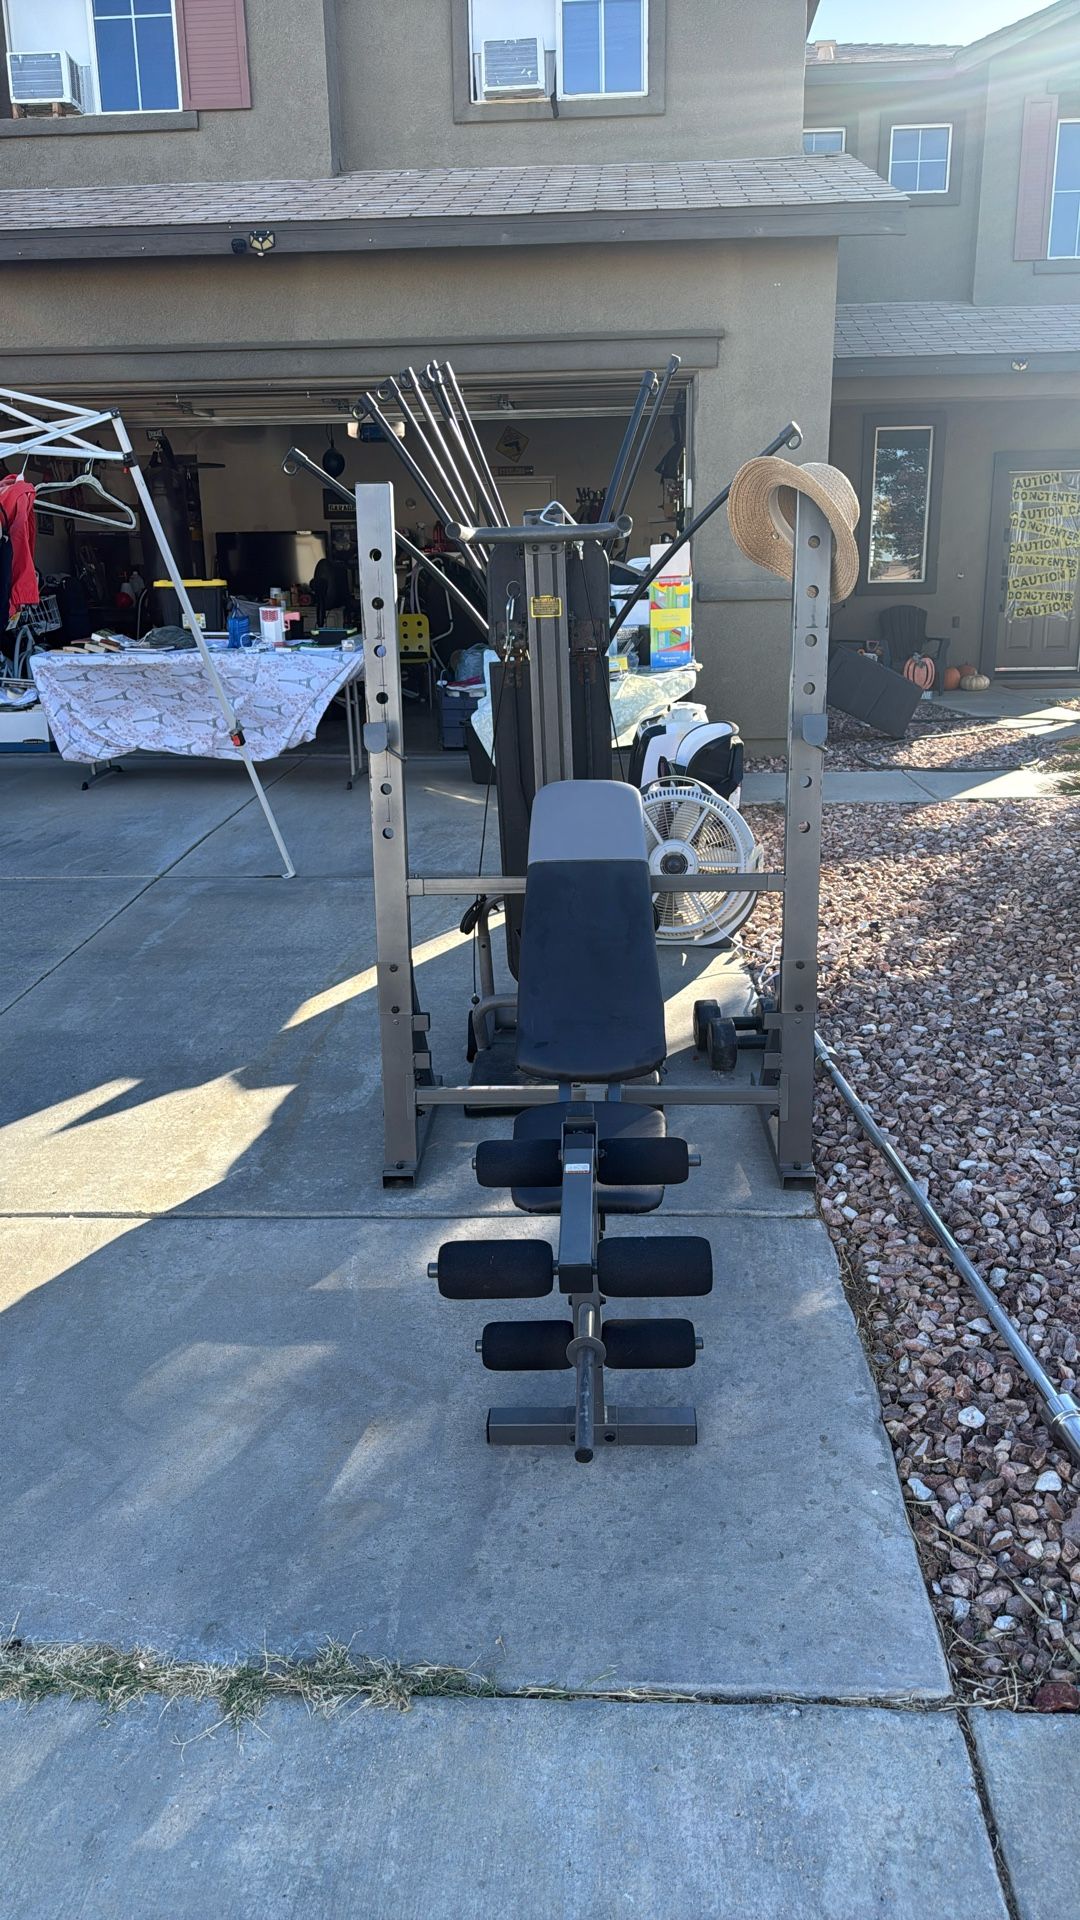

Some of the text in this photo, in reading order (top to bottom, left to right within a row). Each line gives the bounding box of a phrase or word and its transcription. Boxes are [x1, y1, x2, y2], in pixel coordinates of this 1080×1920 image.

[1012, 472, 1060, 490] AUTION
[1013, 491, 1028, 501] DO
[1012, 518, 1027, 529] DO
[1009, 538, 1059, 554] CAUTION
[1009, 555, 1023, 565] DO
[1047, 557, 1077, 569] ENTER
[1012, 569, 1066, 589] CAUTION
[1008, 591, 1022, 600] DO
[1016, 602, 1069, 617] CAUTION
